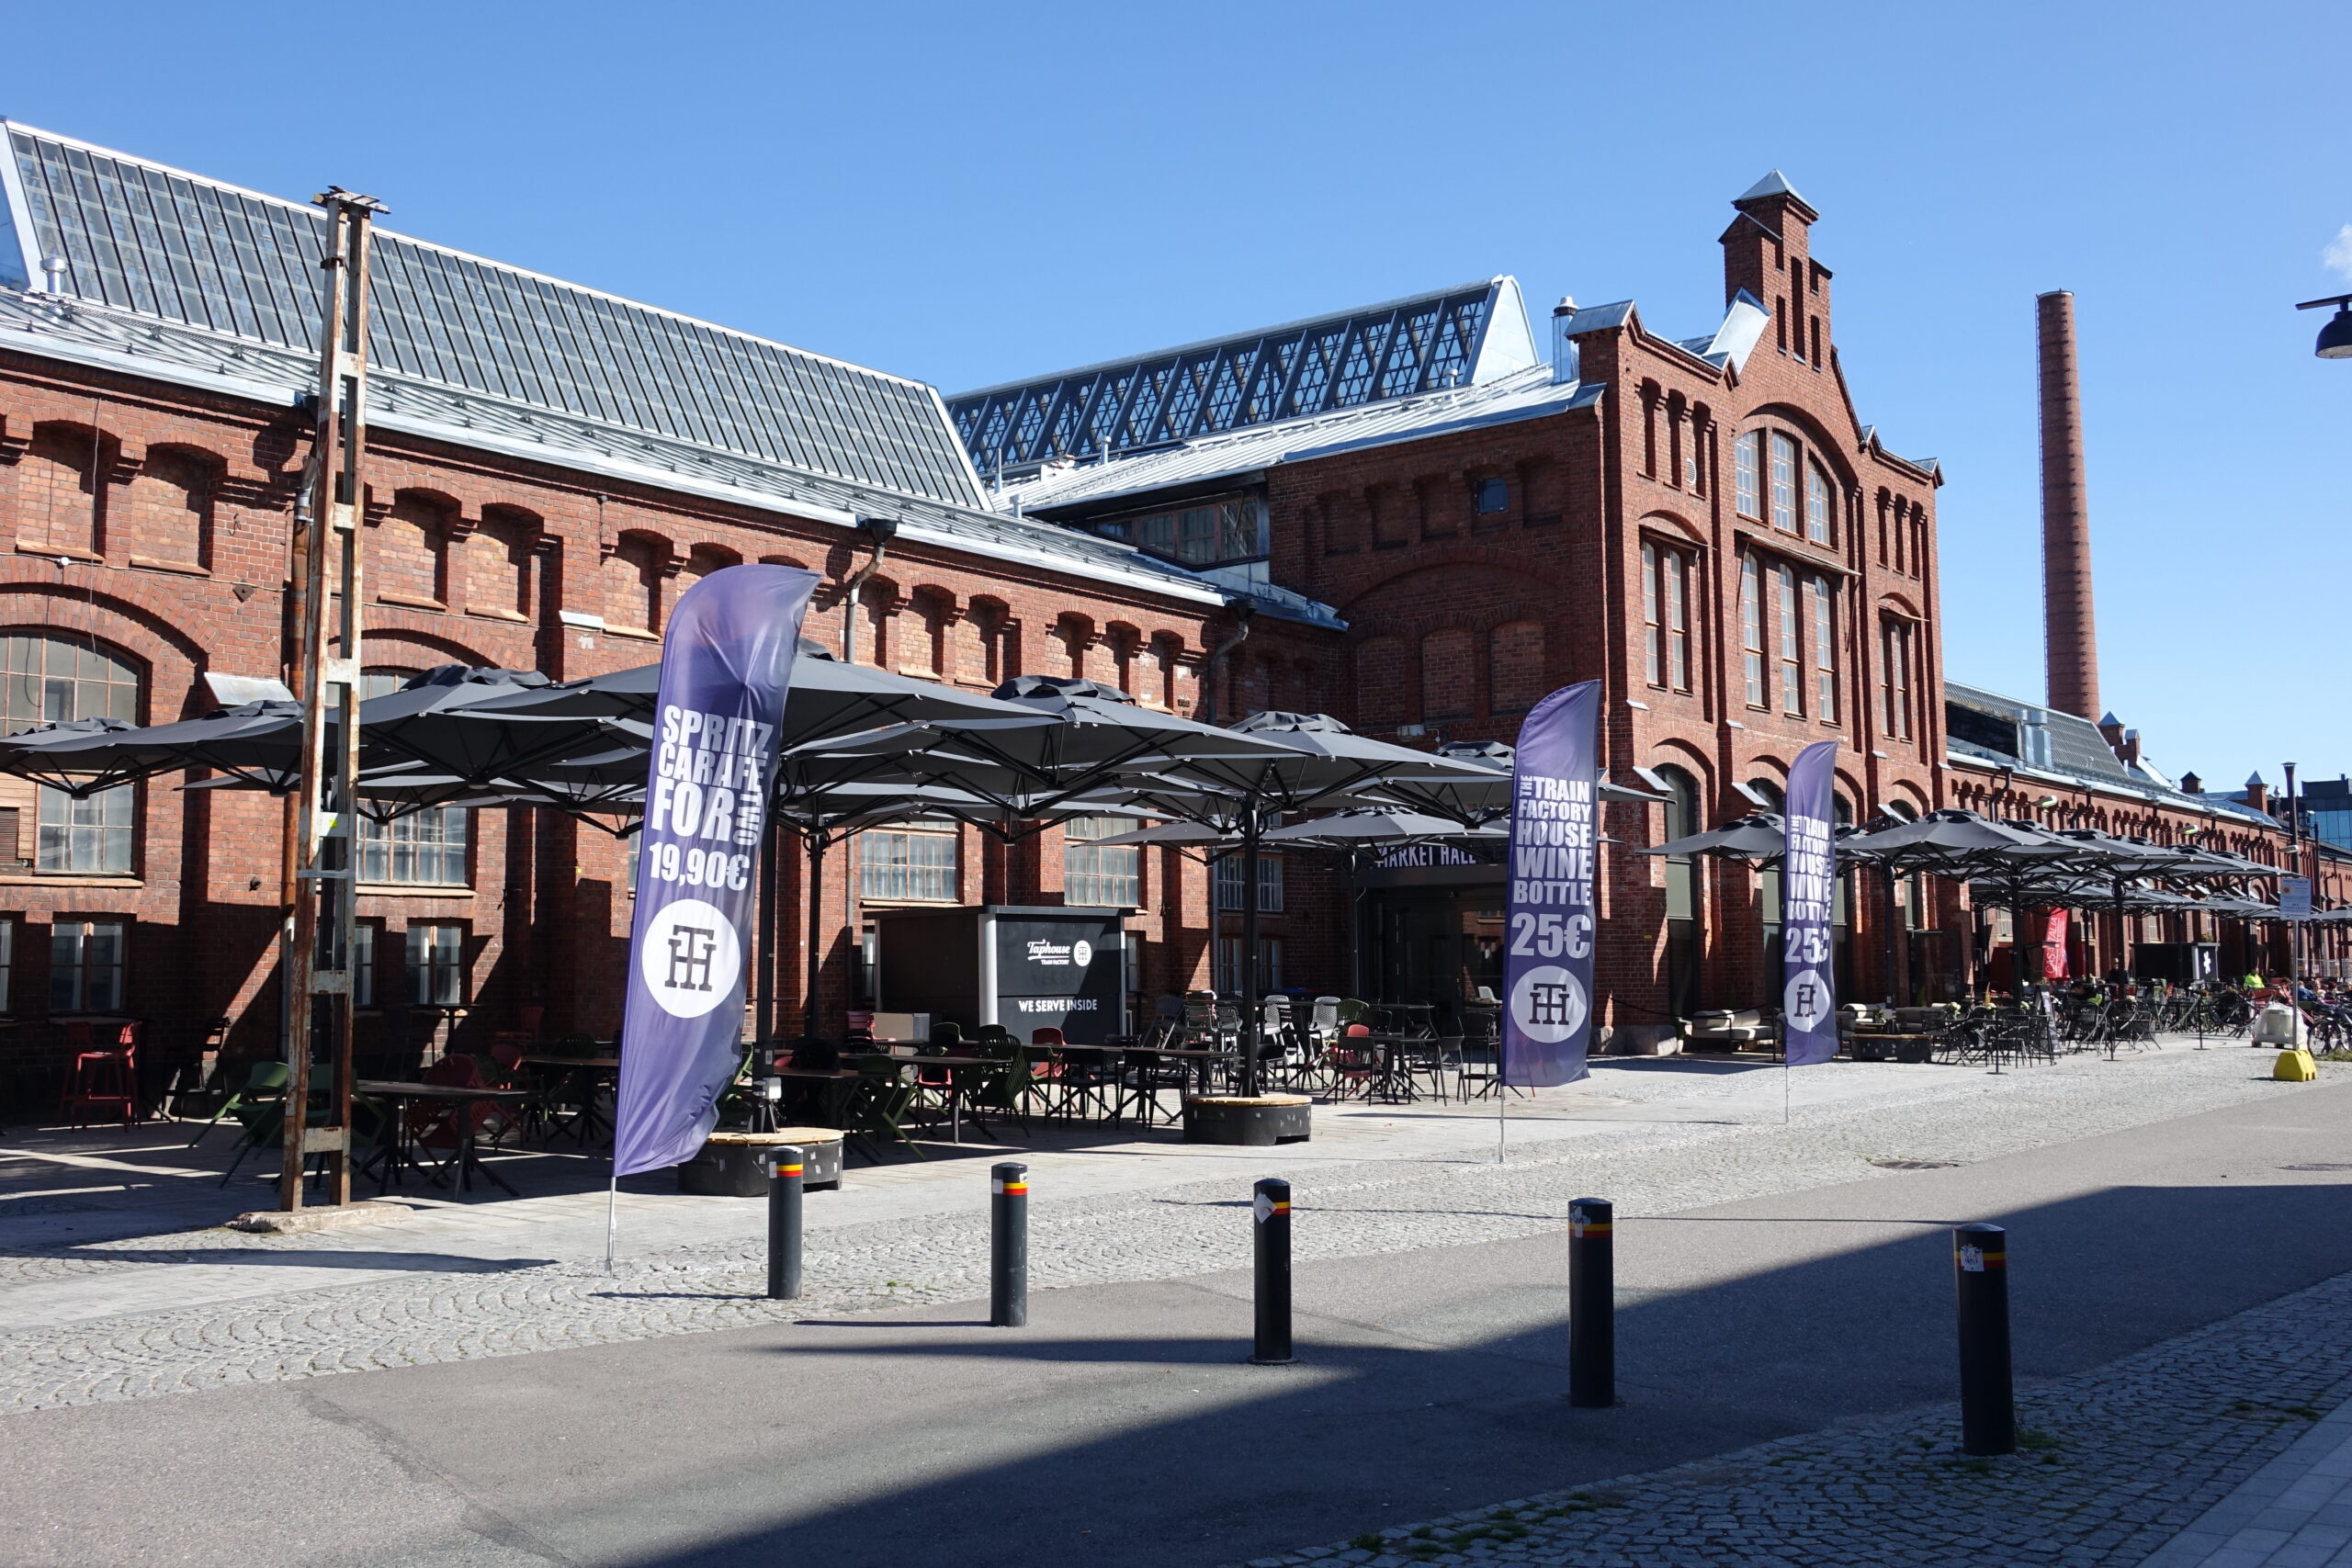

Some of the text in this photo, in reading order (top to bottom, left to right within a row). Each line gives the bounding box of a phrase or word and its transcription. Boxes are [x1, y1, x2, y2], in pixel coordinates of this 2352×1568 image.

[662, 705, 774, 760] SPRITZ
[658, 741, 766, 792] CARAFE
[1520, 775, 1590, 803] THE TRAIN
[651, 775, 763, 846] FOR TWO
[1518, 799, 1591, 822] FACTORY
[1516, 819, 1591, 848] HOUSE
[1799, 816, 1829, 841] TRAIN
[650, 841, 750, 891] 19,90€
[1378, 846, 1433, 867] MARKET
[1516, 846, 1592, 880] WINE
[1790, 852, 1831, 877] HOUSE
[1513, 880, 1592, 906] BOTTLE
[1027, 939, 1070, 957] Taphouse
[1510, 912, 1591, 958] 25€
[1019, 998, 1098, 1012] WE SERVE INSIDE
